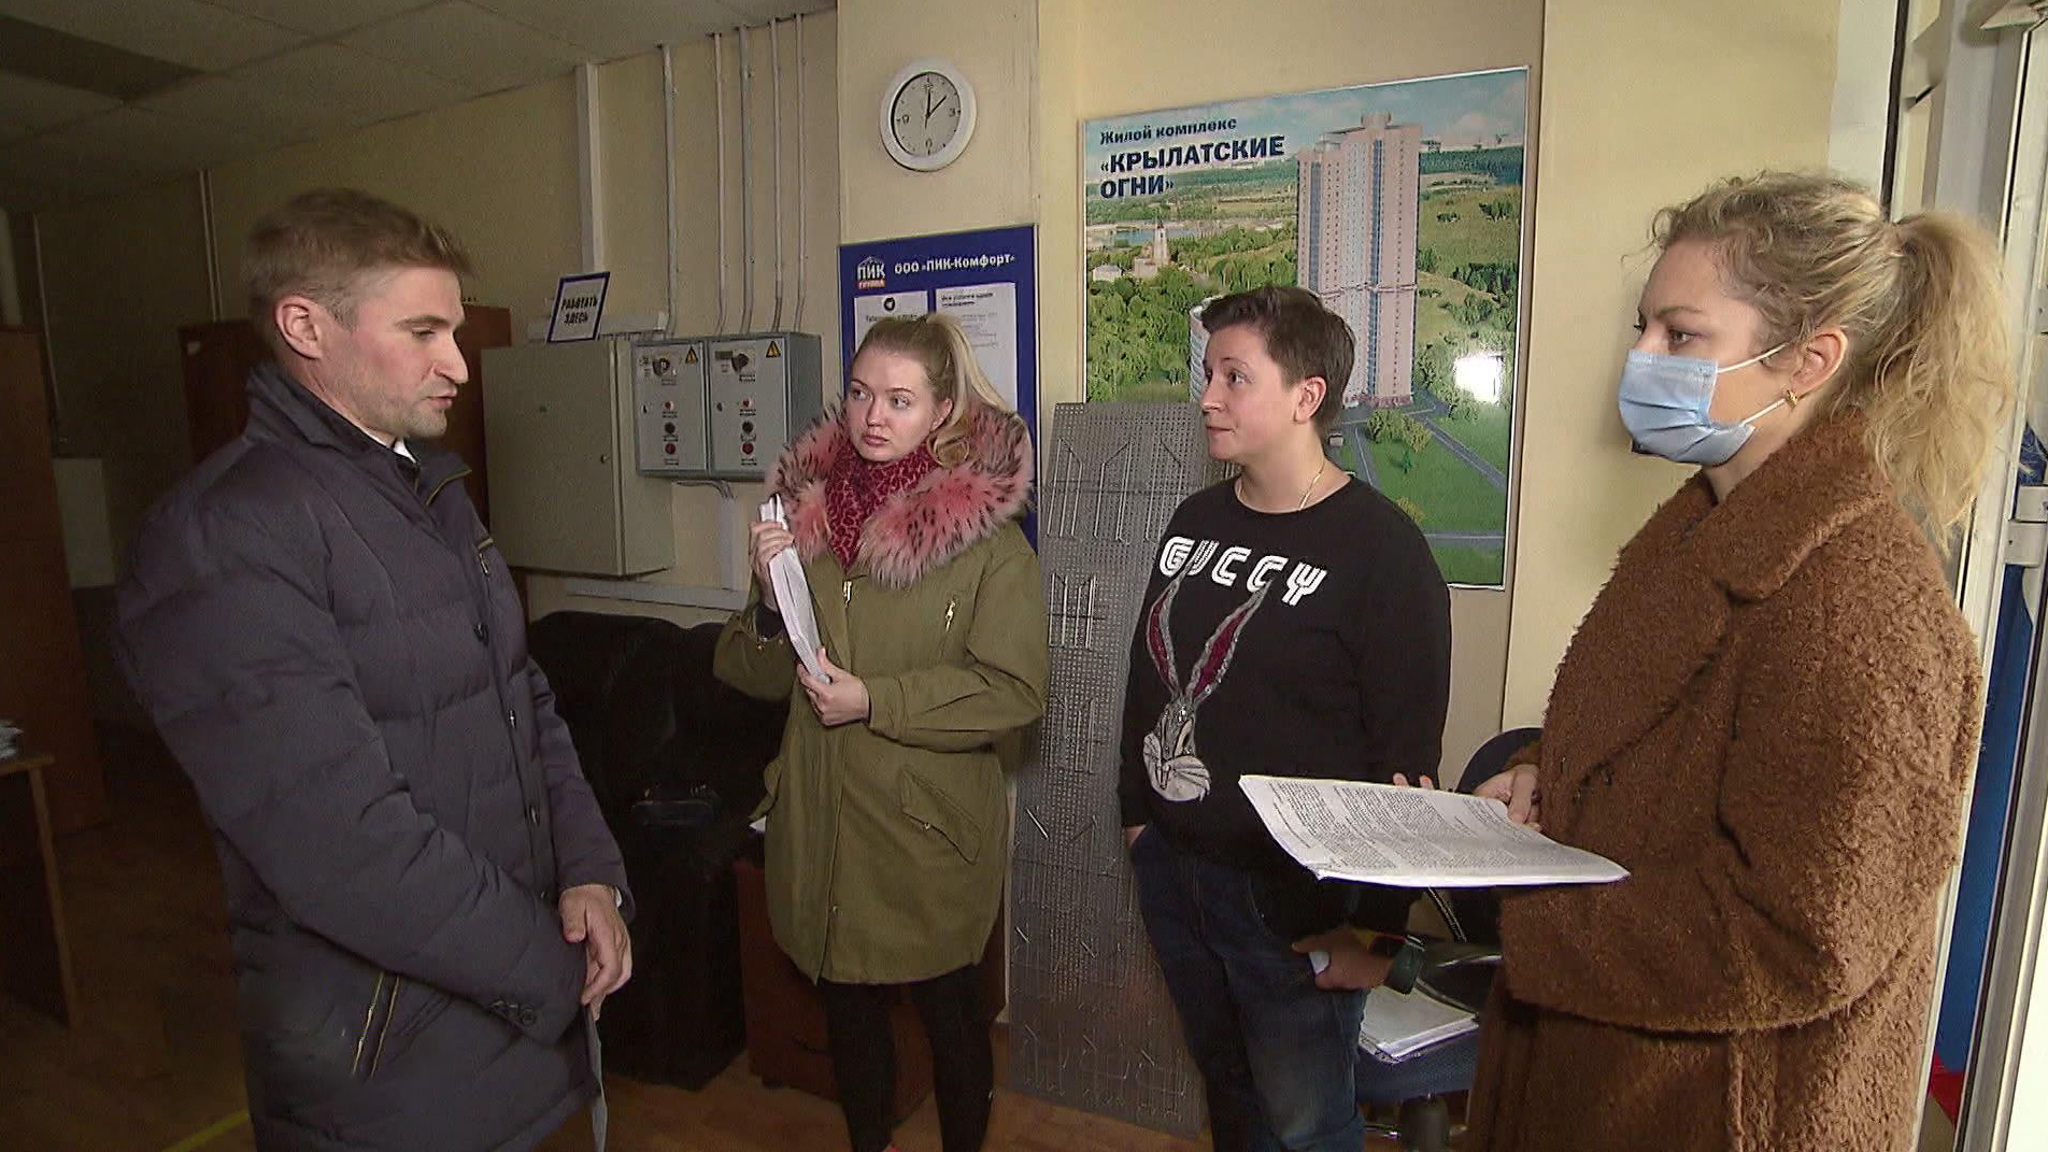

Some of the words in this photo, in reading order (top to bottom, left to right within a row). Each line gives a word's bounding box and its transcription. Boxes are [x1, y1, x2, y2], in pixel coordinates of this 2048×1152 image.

[1100, 125, 1152, 145] Жилой
[1156, 117, 1237, 139] комплекс
[1101, 135, 1285, 173] «КРЫЛАТСКИЕ
[1100, 174, 1174, 199] ОГНИ»
[857, 263, 886, 280] ПИК
[894, 261, 919, 275] ООО
[1159, 536, 1328, 606] GUCCY
